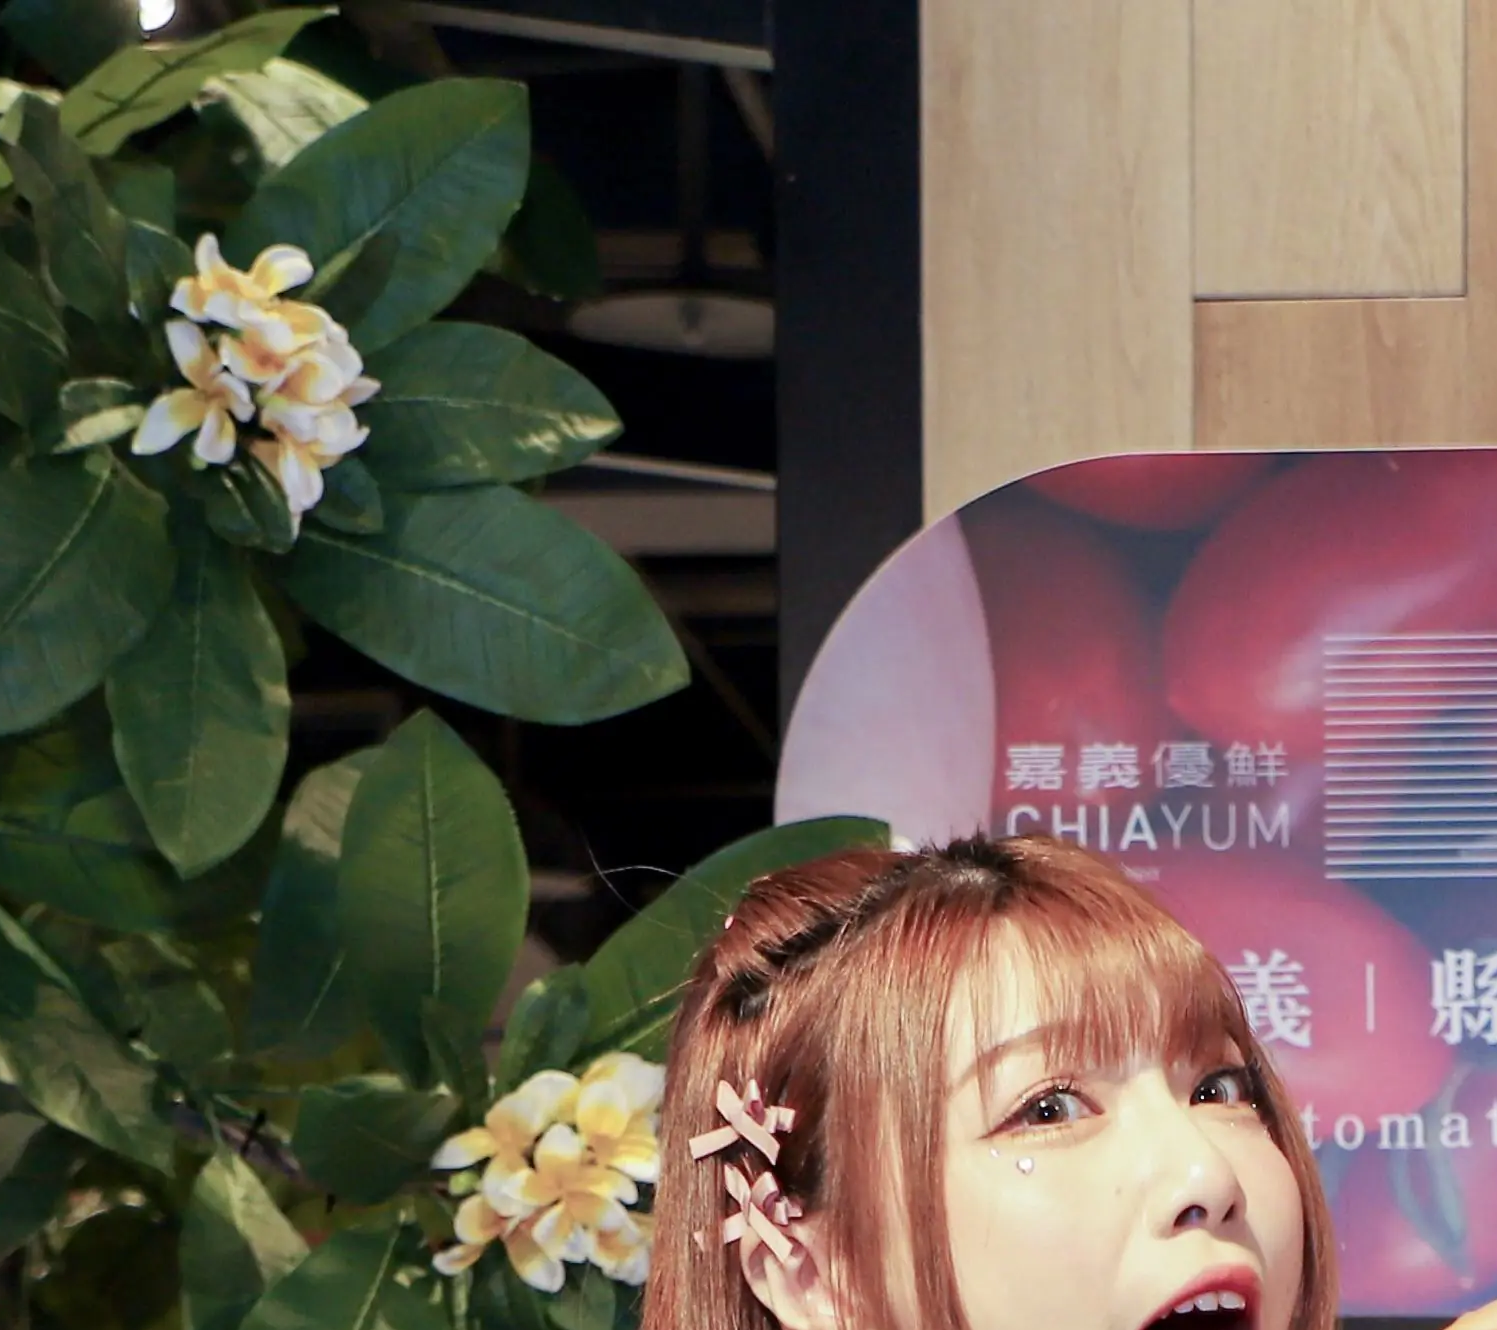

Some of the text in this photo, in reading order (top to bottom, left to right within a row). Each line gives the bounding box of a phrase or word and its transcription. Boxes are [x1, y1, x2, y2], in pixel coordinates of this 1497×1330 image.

[1006, 741, 1289, 790] 嘉義優鮮
[1006, 803, 1290, 851] CHIAYUM
